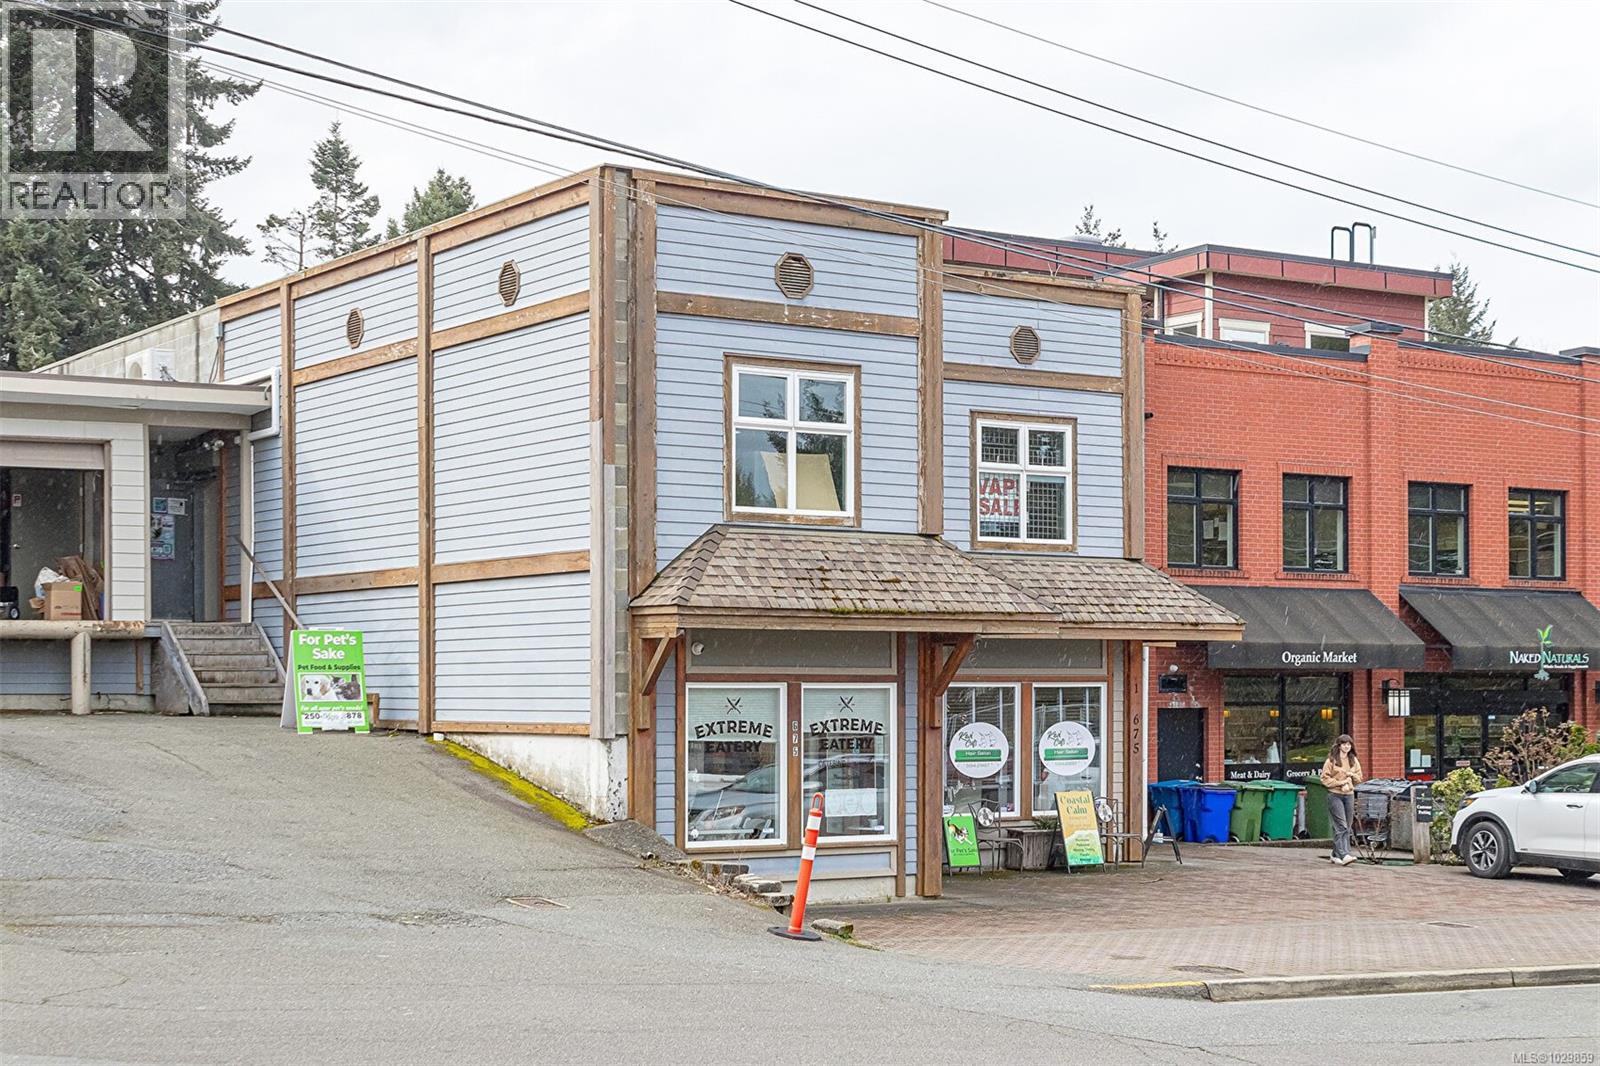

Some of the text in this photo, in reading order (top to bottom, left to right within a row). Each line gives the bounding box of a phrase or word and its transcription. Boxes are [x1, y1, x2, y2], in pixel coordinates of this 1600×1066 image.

[299, 633, 357, 646] For Pet's
[312, 648, 345, 660] Sake
[1281, 651, 1358, 666] Organic Market
[695, 720, 773, 739] EXTREME
[809, 718, 884, 737] EXTREME
[705, 741, 762, 752] EATERY
[819, 737, 874, 750] EATERY
[1231, 771, 1246, 779] Meat
[1254, 770, 1271, 780] Dairy
[1060, 795, 1090, 804] Coastal
[1067, 806, 1087, 814] Calm
